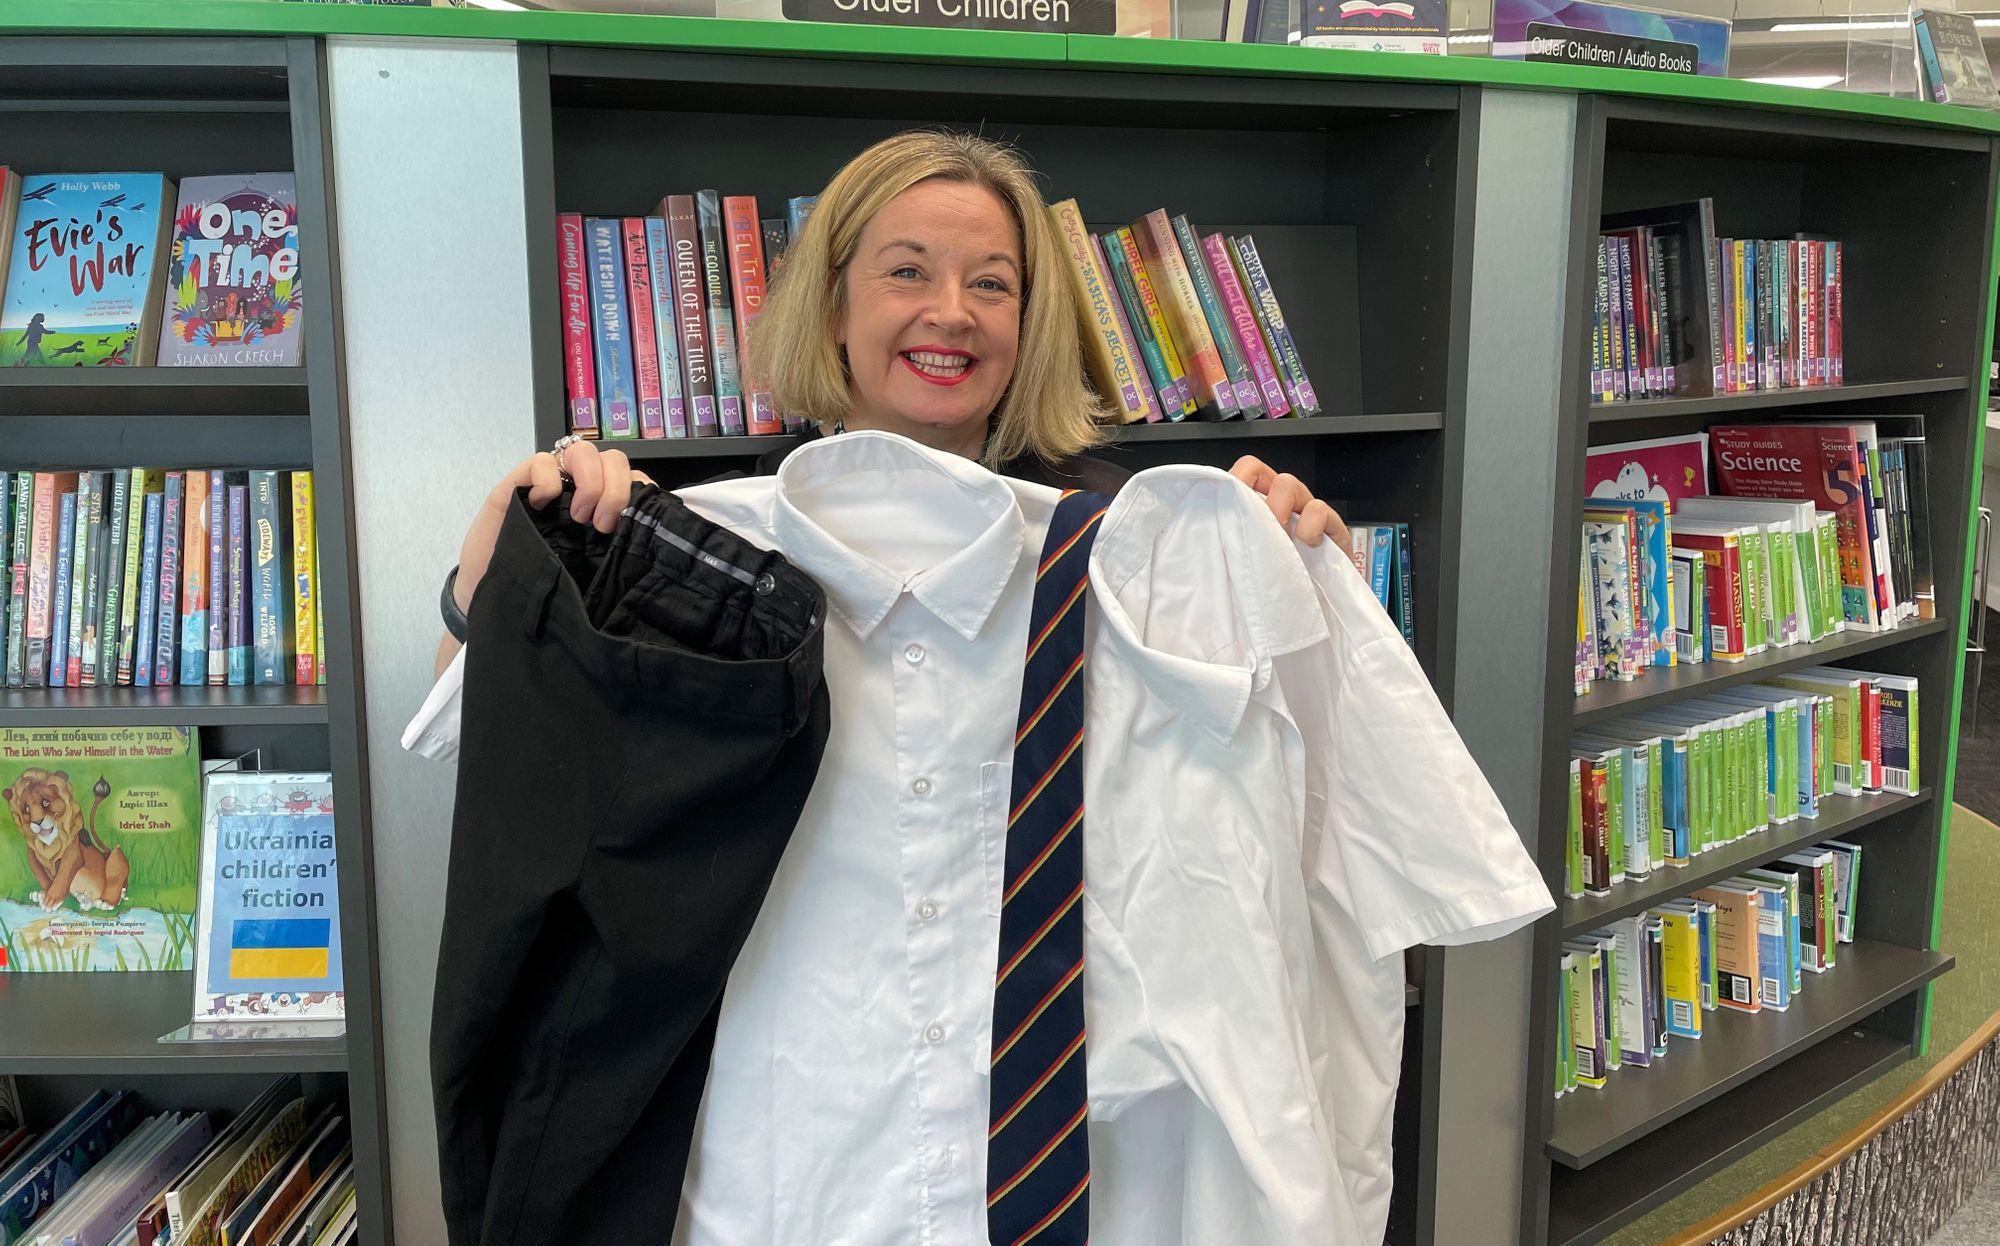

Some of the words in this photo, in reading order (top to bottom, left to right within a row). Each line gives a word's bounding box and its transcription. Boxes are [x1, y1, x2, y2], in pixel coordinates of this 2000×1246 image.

[833, 0, 920, 14] Older
[937, 0, 1070, 22] Children
[1531, 36, 1565, 57] Older
[1567, 41, 1615, 64] Children
[1617, 48, 1623, 64] /
[1624, 49, 1656, 68] Audio
[1659, 53, 1692, 73] Books
[61, 182, 90, 193] Holly
[92, 181, 121, 191] Webb
[201, 202, 298, 239] One
[24, 209, 123, 271] Evie's
[562, 222, 580, 268] Coming
[706, 241, 715, 253] THE
[69, 242, 144, 297] War
[189, 239, 298, 288] Time
[595, 226, 616, 300] WATERSHIP
[676, 239, 695, 288] QUEEN
[1158, 218, 1175, 257] RUNNING
[1178, 278, 1193, 310] HORSES
[1180, 226, 1189, 240] WE
[1185, 241, 1199, 267] WERE
[1194, 268, 1213, 304] WOLVES
[1240, 244, 1262, 289] COLFER
[1609, 247, 1618, 276] NIGHT
[1621, 244, 1631, 271] NIGHT
[565, 269, 582, 291] Up
[705, 255, 721, 296] COLOUR
[1123, 233, 1144, 276] THREE
[1137, 277, 1159, 317] GIRLS
[1658, 253, 1666, 290] SIXTEEN
[568, 293, 584, 314] For
[682, 293, 698, 309] OF
[1212, 252, 1225, 279] All
[1231, 304, 1257, 351] Glitters
[1260, 288, 1285, 331] WARP
[1660, 290, 1668, 318] SOULS
[570, 316, 587, 335] Air
[602, 303, 620, 341] DOWN
[685, 315, 701, 341] THE
[1083, 266, 1112, 325] SASHA'S
[1102, 328, 1133, 384] SECRET
[714, 324, 726, 347] SUN
[1265, 327, 1276, 350] STEVE
[1274, 348, 1285, 366] COLE
[174, 350, 228, 366] SHARON
[234, 349, 284, 364] CREECH
[688, 345, 706, 383] TILES
[1126, 391, 1137, 401] OC
[1168, 396, 1178, 405] OC
[1178, 385, 1188, 394] OC
[1222, 391, 1232, 400] OC
[1239, 388, 1250, 398] OC
[1269, 388, 1280, 397] OC
[1303, 390, 1313, 399] OC
[576, 406, 591, 415] OC
[613, 411, 626, 421] OC
[646, 407, 659, 415] OC
[670, 407, 683, 415] OC
[698, 406, 711, 415] OC
[724, 407, 736, 416] OC
[1726, 440, 1750, 449] STUDY
[1753, 441, 1783, 449] GUIDES
[1821, 443, 1853, 451] Science
[1721, 451, 1802, 473] Science
[19, 477, 30, 509] DANNY
[35, 487, 52, 520] Holly
[113, 482, 124, 514] HOLLY
[259, 480, 268, 502] INTO
[1633, 489, 1645, 500] to
[89, 492, 101, 525] STAR
[130, 493, 141, 522] LOST
[17, 510, 27, 554] WALLACE
[38, 521, 51, 554] Webb
[111, 516, 122, 544] WEBB
[128, 526, 139, 552] BEAR
[258, 520, 270, 562] SIDEWAYS
[126, 555, 137, 577] CUB
[212, 561, 220, 587] HOLLY
[56, 577, 66, 617] FEATHER
[142, 577, 153, 616] FEATHER
[212, 590, 220, 616] WEBB
[260, 606, 269, 645] WELFORD
[268, 615, 276, 635] ROSS
[3, 730, 29, 744] Лев,
[32, 729, 59, 742] який
[62, 730, 108, 741] побачив
[110, 729, 136, 741] себе
[138, 732, 144, 744] у
[146, 728, 173, 742] воді
[4, 747, 20, 757] The
[22, 746, 40, 757] Lion
[42, 746, 63, 757] Who
[65, 746, 82, 757] Saw
[84, 746, 116, 757] Himself
[119, 746, 128, 756] in
[130, 745, 144, 756] the
[146, 745, 174, 756] Water
[127, 789, 159, 799] Автор:
[146, 800, 169, 808] Шах
[119, 820, 145, 829] Idries
[148, 820, 171, 829] Shah
[139, 812, 149, 821] by
[221, 858, 336, 880] children'
[241, 888, 325, 909] fiction
